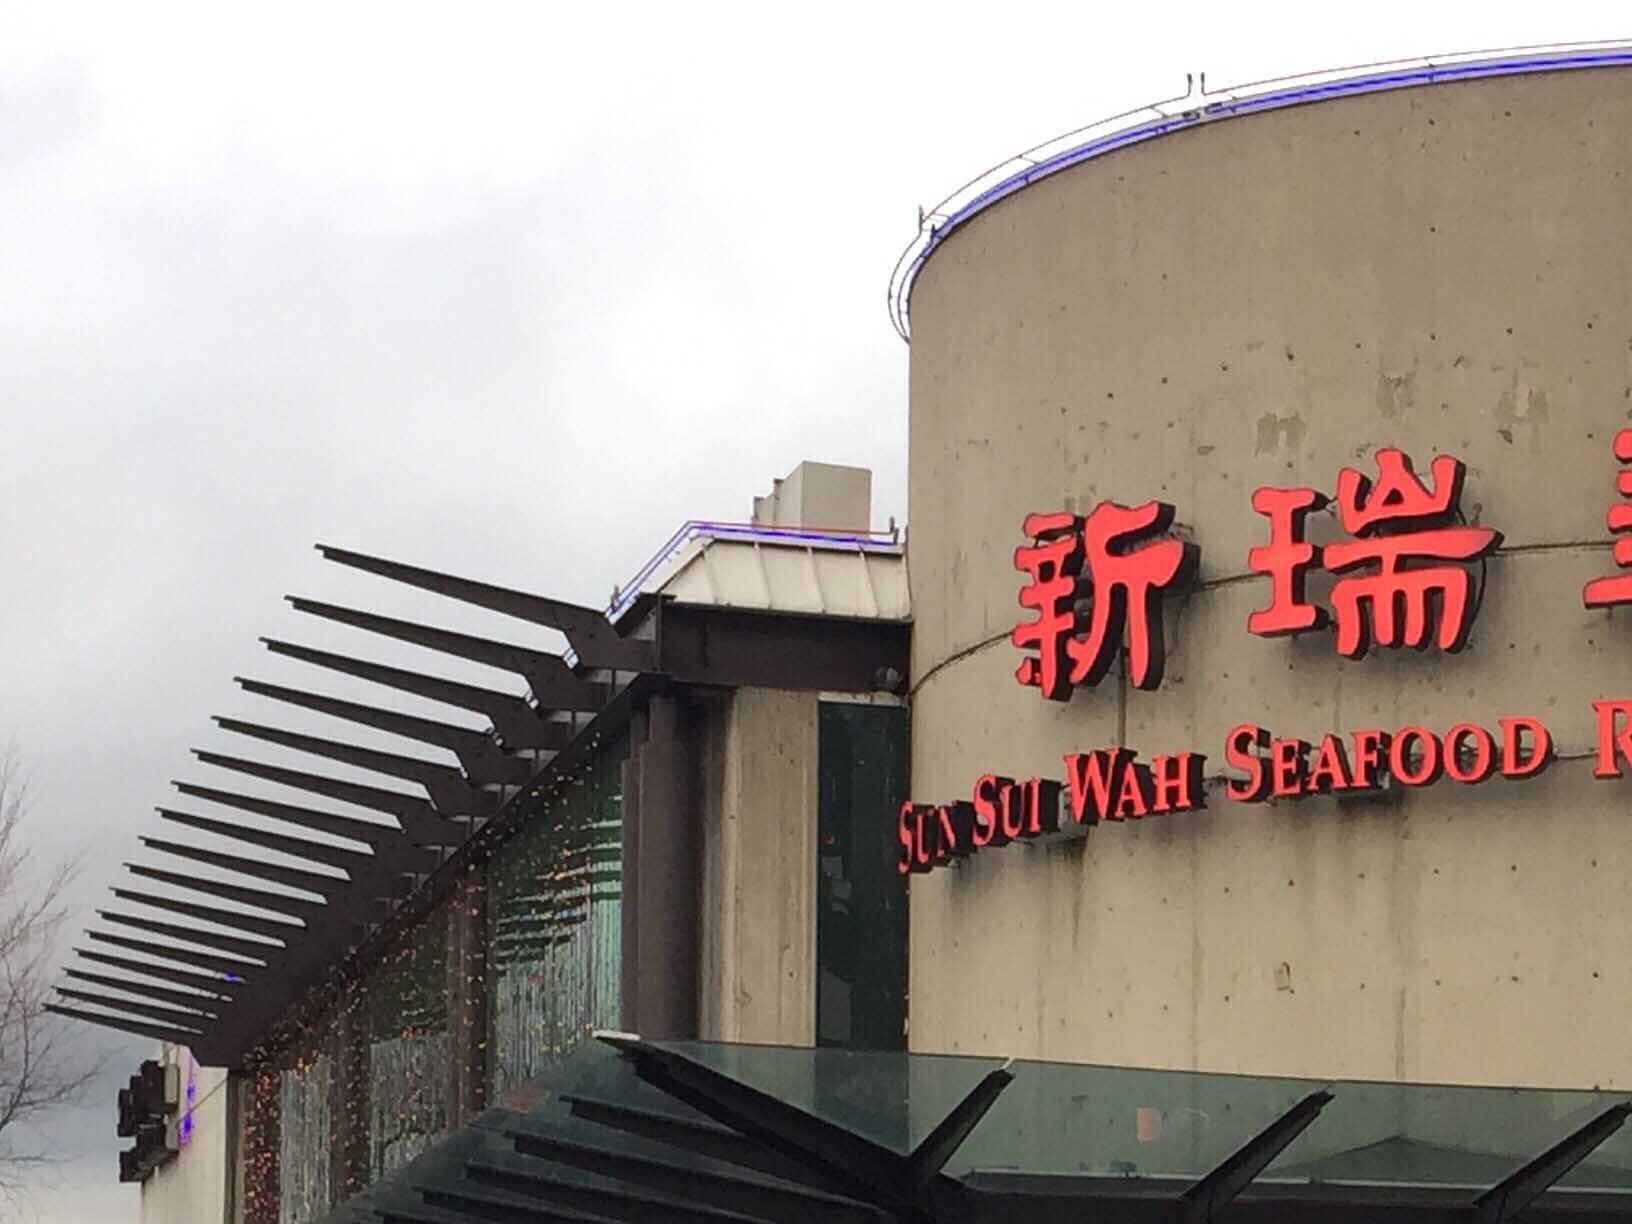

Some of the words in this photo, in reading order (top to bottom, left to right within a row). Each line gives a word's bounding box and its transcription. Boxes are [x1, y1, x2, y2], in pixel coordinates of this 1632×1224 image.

[898, 799, 962, 874] SUN
[971, 772, 1042, 847] SUI
[1062, 747, 1194, 823] WAH
[1223, 715, 1552, 803] SEAFOOD
